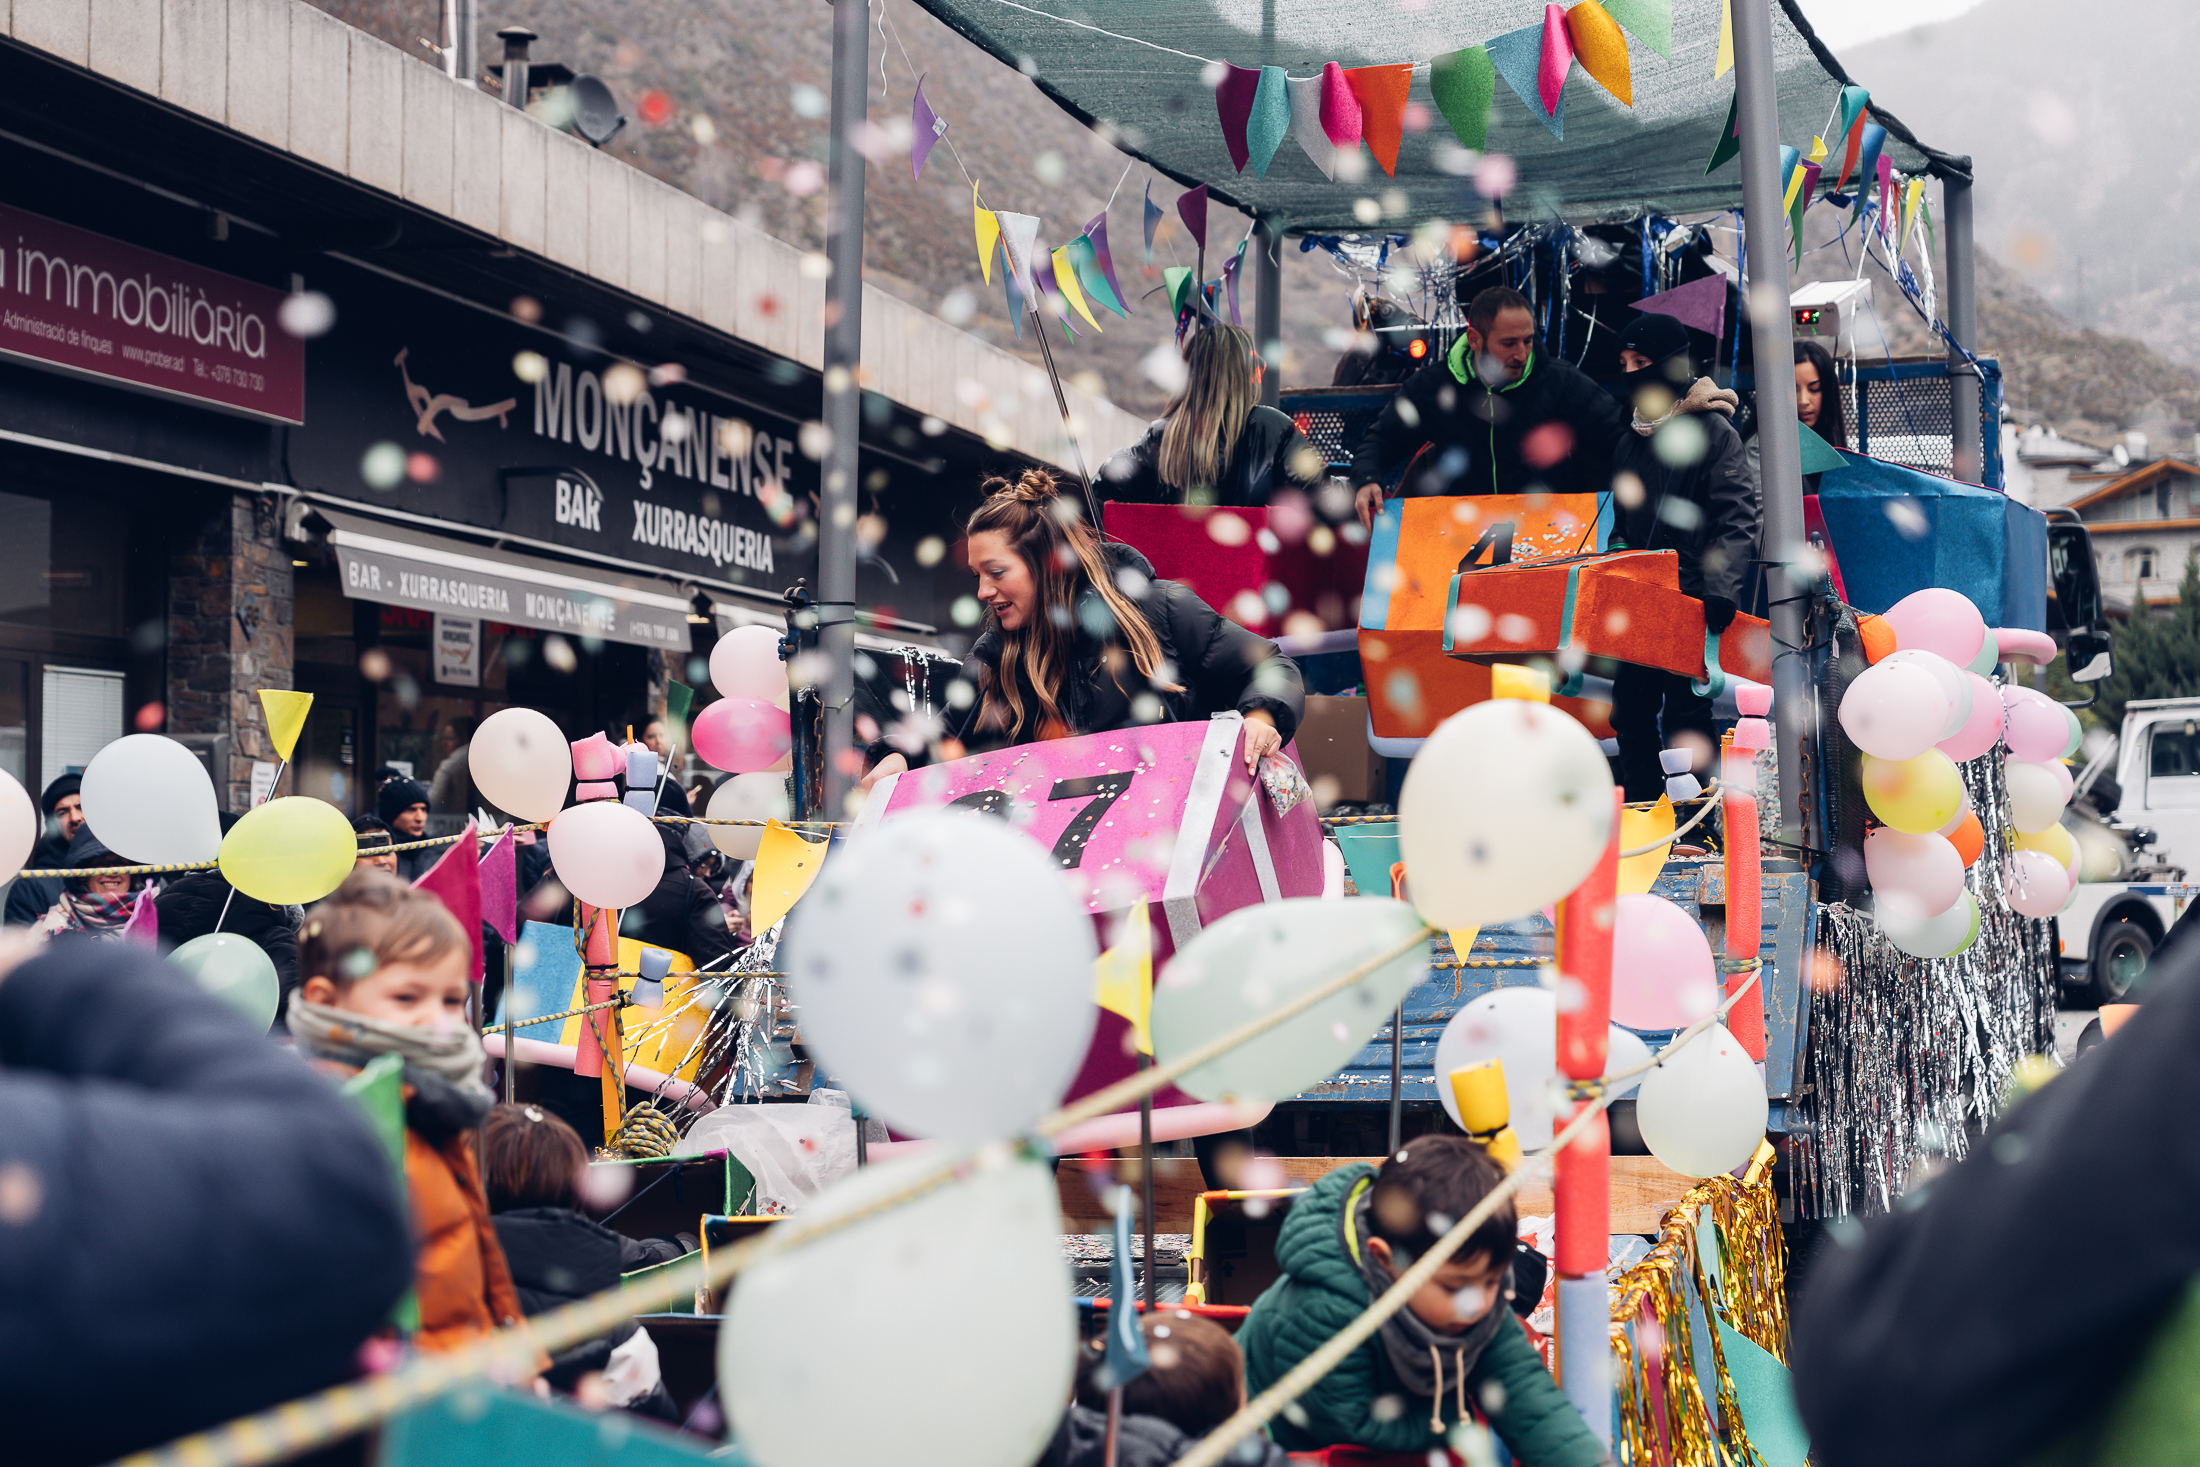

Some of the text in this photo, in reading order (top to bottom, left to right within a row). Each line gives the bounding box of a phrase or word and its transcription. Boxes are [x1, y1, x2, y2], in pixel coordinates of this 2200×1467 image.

[3, 309, 65, 343] Administració
[66, 327, 79, 346] de
[81, 329, 114, 355] finques
[233, 368, 247, 389] 730
[249, 372, 266, 393] 730
[555, 478, 774, 574] BAR XURRASQUERIA
[1458, 521, 1515, 574] 4
[349, 561, 381, 591] BAR
[400, 571, 511, 613] XURRASQUERIA
